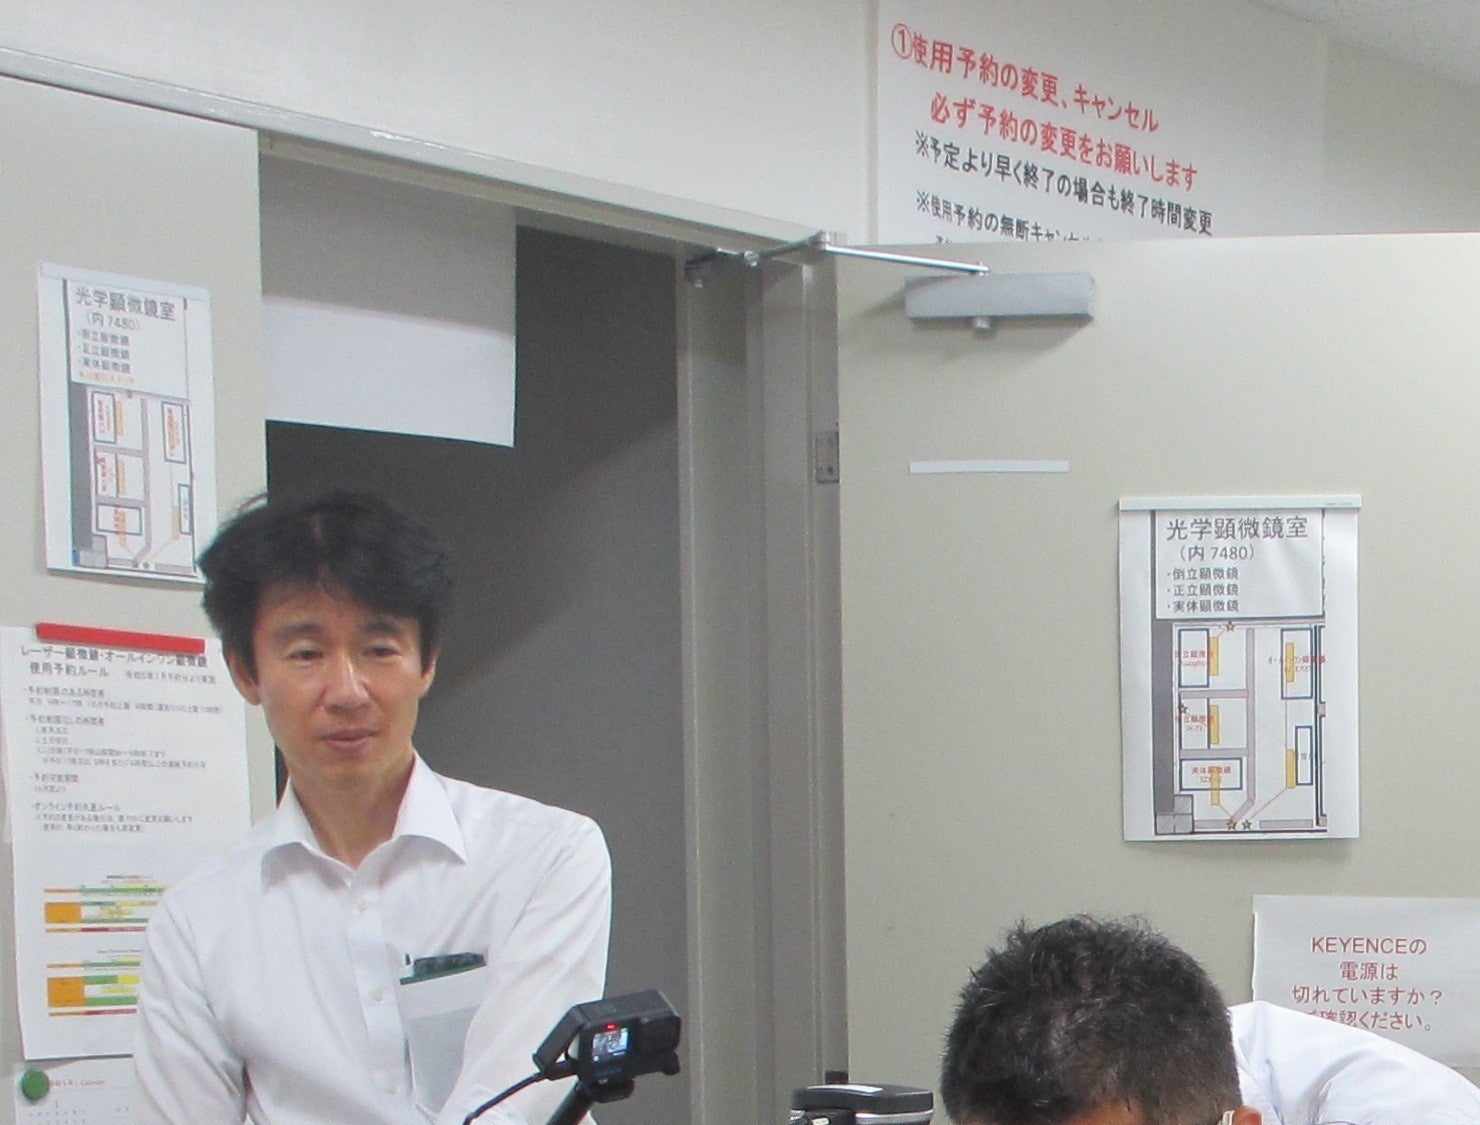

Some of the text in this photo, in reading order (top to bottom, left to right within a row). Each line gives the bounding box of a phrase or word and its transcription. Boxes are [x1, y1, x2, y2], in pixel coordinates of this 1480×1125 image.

[891, 23, 1159, 132] ①使用予約の変更、キャンセル
[930, 92, 1199, 191] 必ず予約の変更をお願いします
[914, 129, 1213, 236] ※予定より早く終了の場合も終了時間変更
[1166, 516, 1309, 541] 光学顕微鏡室
[1311, 936, 1427, 955] KEYENCEの
[1340, 961, 1398, 981] 電源は
[1292, 985, 1442, 1005] 切れていますか？
